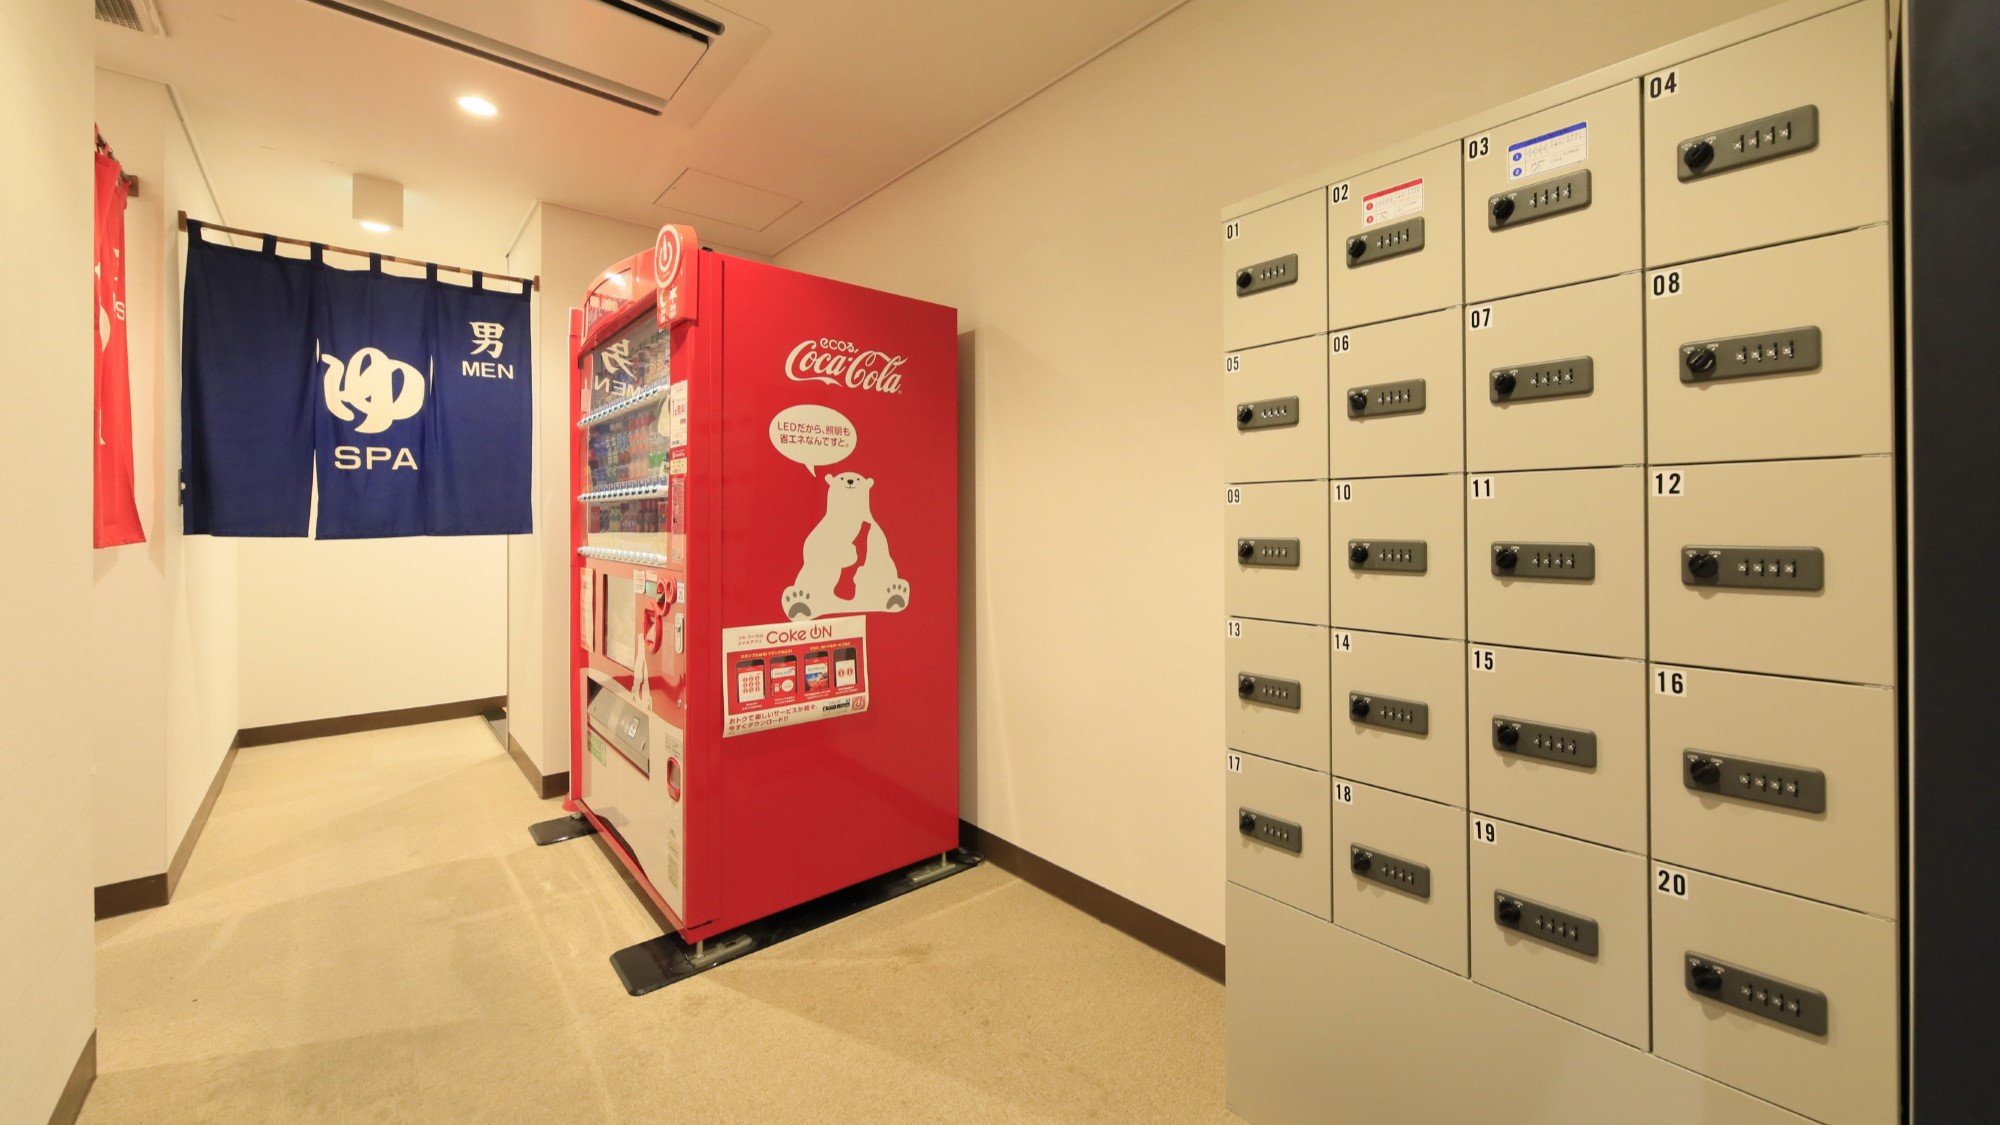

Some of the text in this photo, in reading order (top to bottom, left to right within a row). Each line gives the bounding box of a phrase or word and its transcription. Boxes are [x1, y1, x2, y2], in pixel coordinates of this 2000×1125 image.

[1650, 71, 1677, 99] 04
[1469, 136, 1489, 159] 03
[1333, 183, 1349, 203] 02
[1227, 223, 1239, 239] 01
[1653, 272, 1680, 296] 08
[1471, 307, 1491, 329] 07
[469, 321, 504, 359] 男
[1333, 335, 1349, 352] 06
[462, 360, 514, 379] MEN
[785, 340, 908, 394] Coca-Cola
[1227, 357, 1239, 372] 05
[777, 421, 851, 436] LEDだから、照明も
[780, 434, 849, 448] 省エネなんですと。
[334, 445, 418, 470] SPA
[1336, 484, 1351, 500] 10
[1472, 478, 1490, 498] 11
[1655, 472, 1681, 495] 12
[1227, 489, 1240, 503] 09
[766, 629, 807, 644] Coke
[1229, 622, 1240, 637] 13
[1335, 633, 1350, 651] 14
[1474, 650, 1494, 670] 15
[1657, 671, 1684, 694] 16
[1229, 755, 1240, 771] 17
[1336, 783, 1351, 803] 18
[1475, 820, 1495, 843] 19
[1658, 869, 1686, 896] 20
